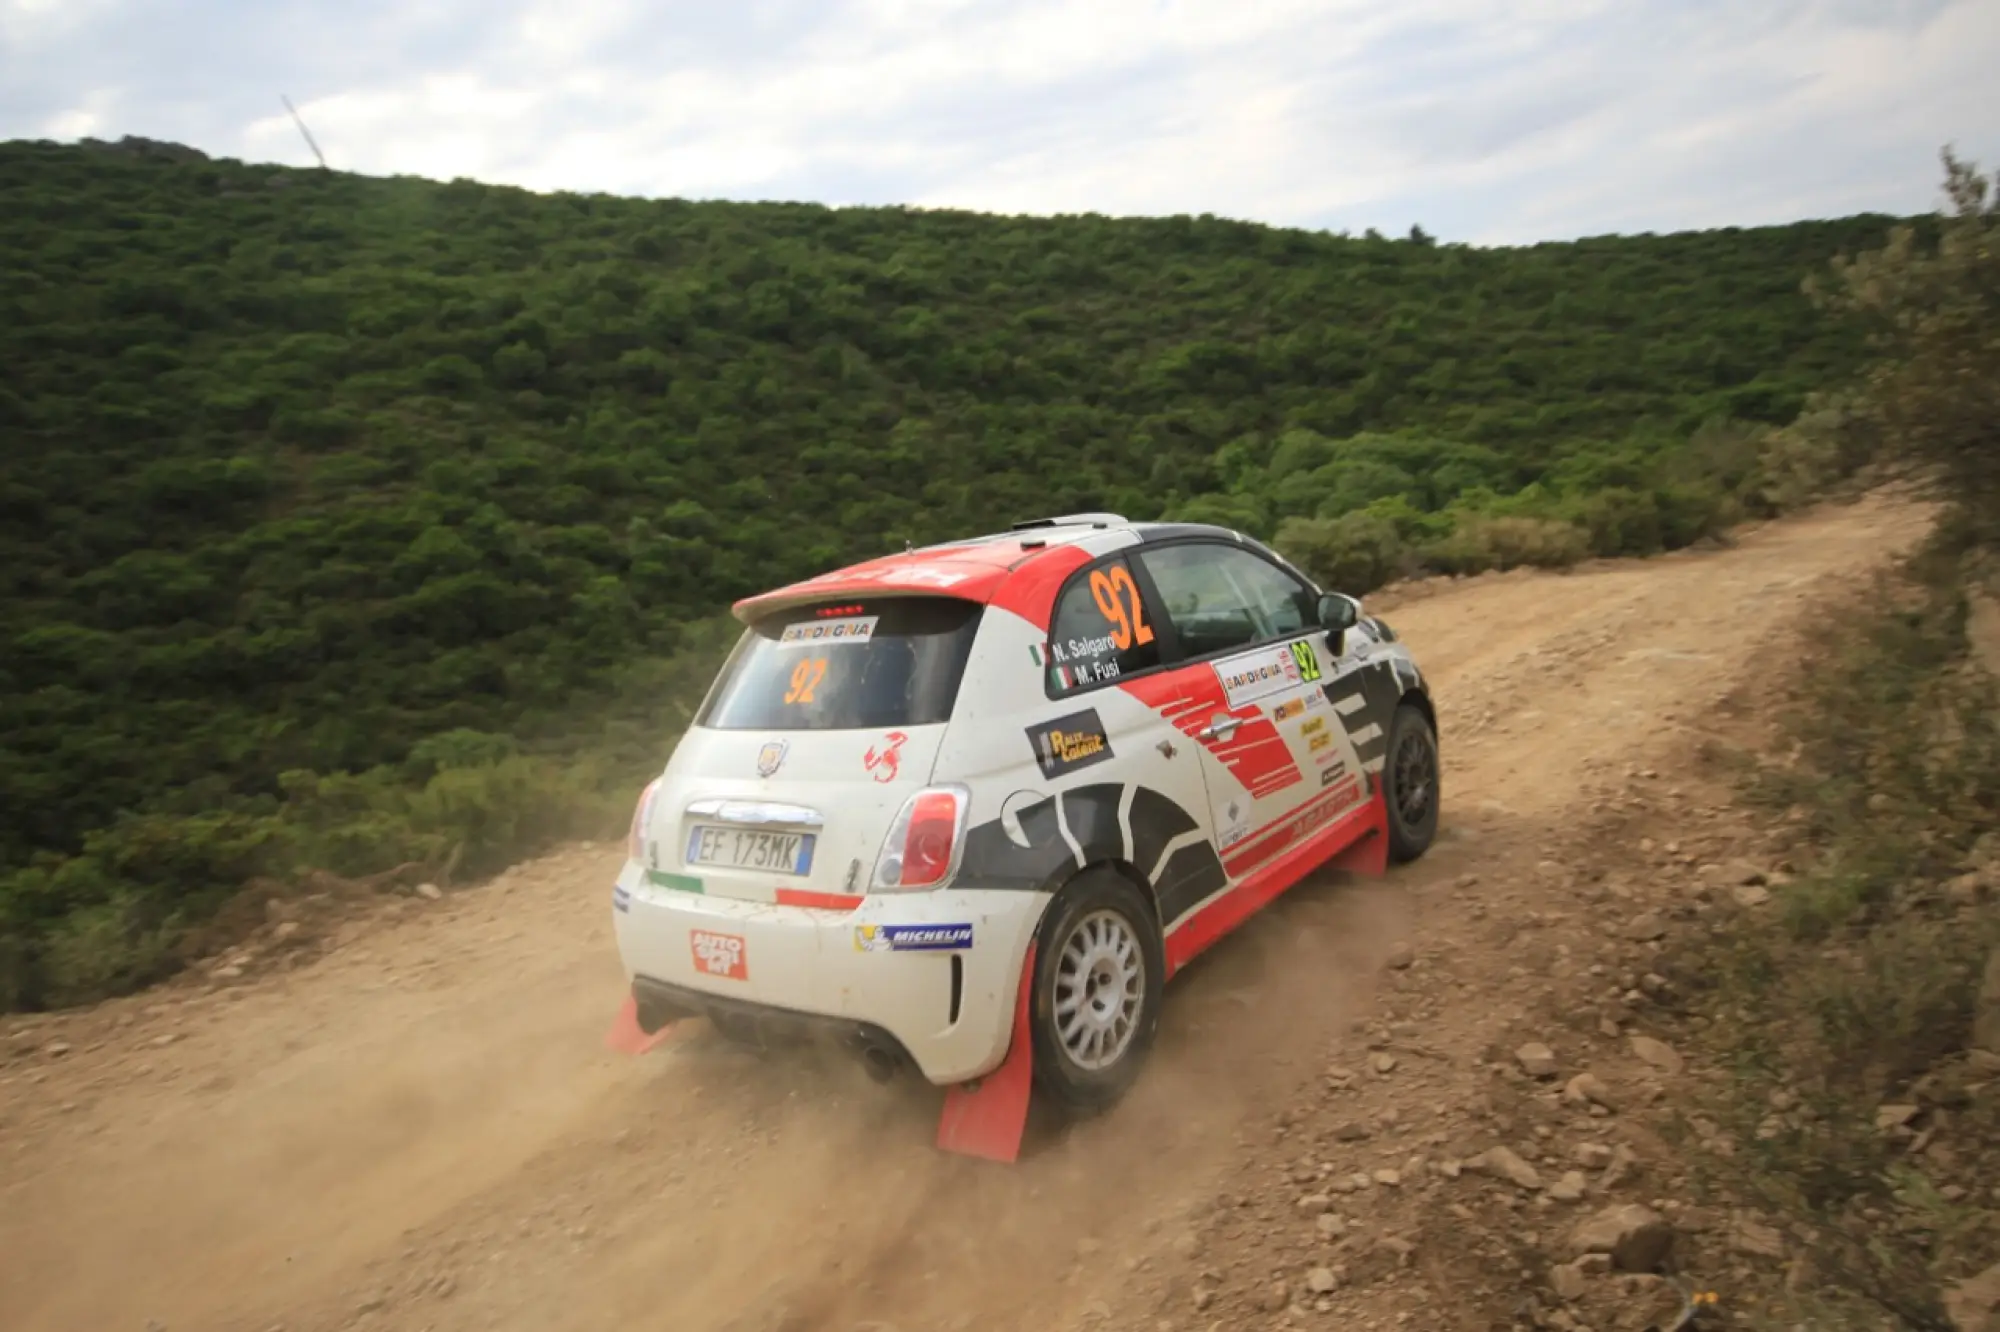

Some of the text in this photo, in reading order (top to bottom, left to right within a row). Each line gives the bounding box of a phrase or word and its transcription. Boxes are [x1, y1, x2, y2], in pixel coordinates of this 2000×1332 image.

[1089, 565, 1154, 650] 92
[783, 622, 870, 641] SARDEGNA
[1052, 636, 1116, 663] N. Salgaro
[1291, 640, 1321, 682] 92
[784, 657, 827, 704] 92
[1075, 657, 1120, 685] M. Fusi
[1225, 663, 1282, 690] SARDEGNA
[699, 829, 798, 869] EF 173MK
[893, 929, 972, 942] MICHELIN
